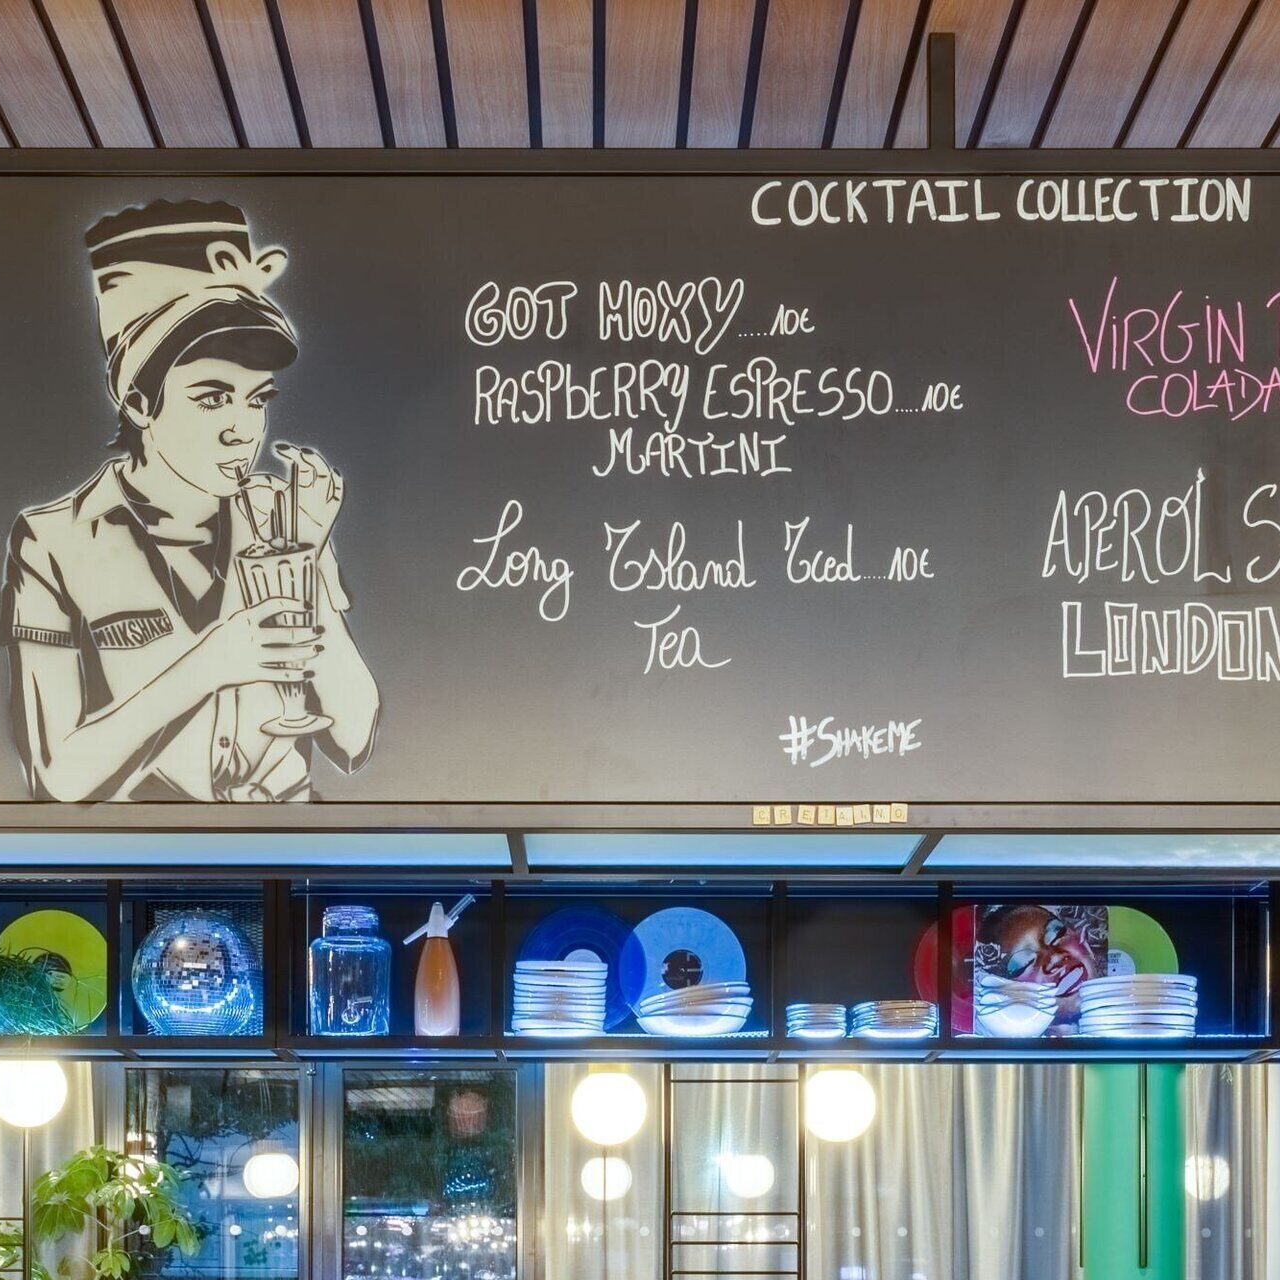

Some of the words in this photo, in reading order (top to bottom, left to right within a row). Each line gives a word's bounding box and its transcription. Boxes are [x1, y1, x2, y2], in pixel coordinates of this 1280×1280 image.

[751, 179, 1001, 226] COCKTAIL
[1016, 178, 1252, 224] COLLECTION
[464, 280, 578, 346] GOT
[598, 277, 745, 355] MOXY
[703, 356, 893, 427] ESPRESSO
[591, 428, 793, 479] MARTINI
[455, 499, 574, 622] Long
[1041, 466, 1232, 585] APEROL
[633, 603, 732, 675] Tea
